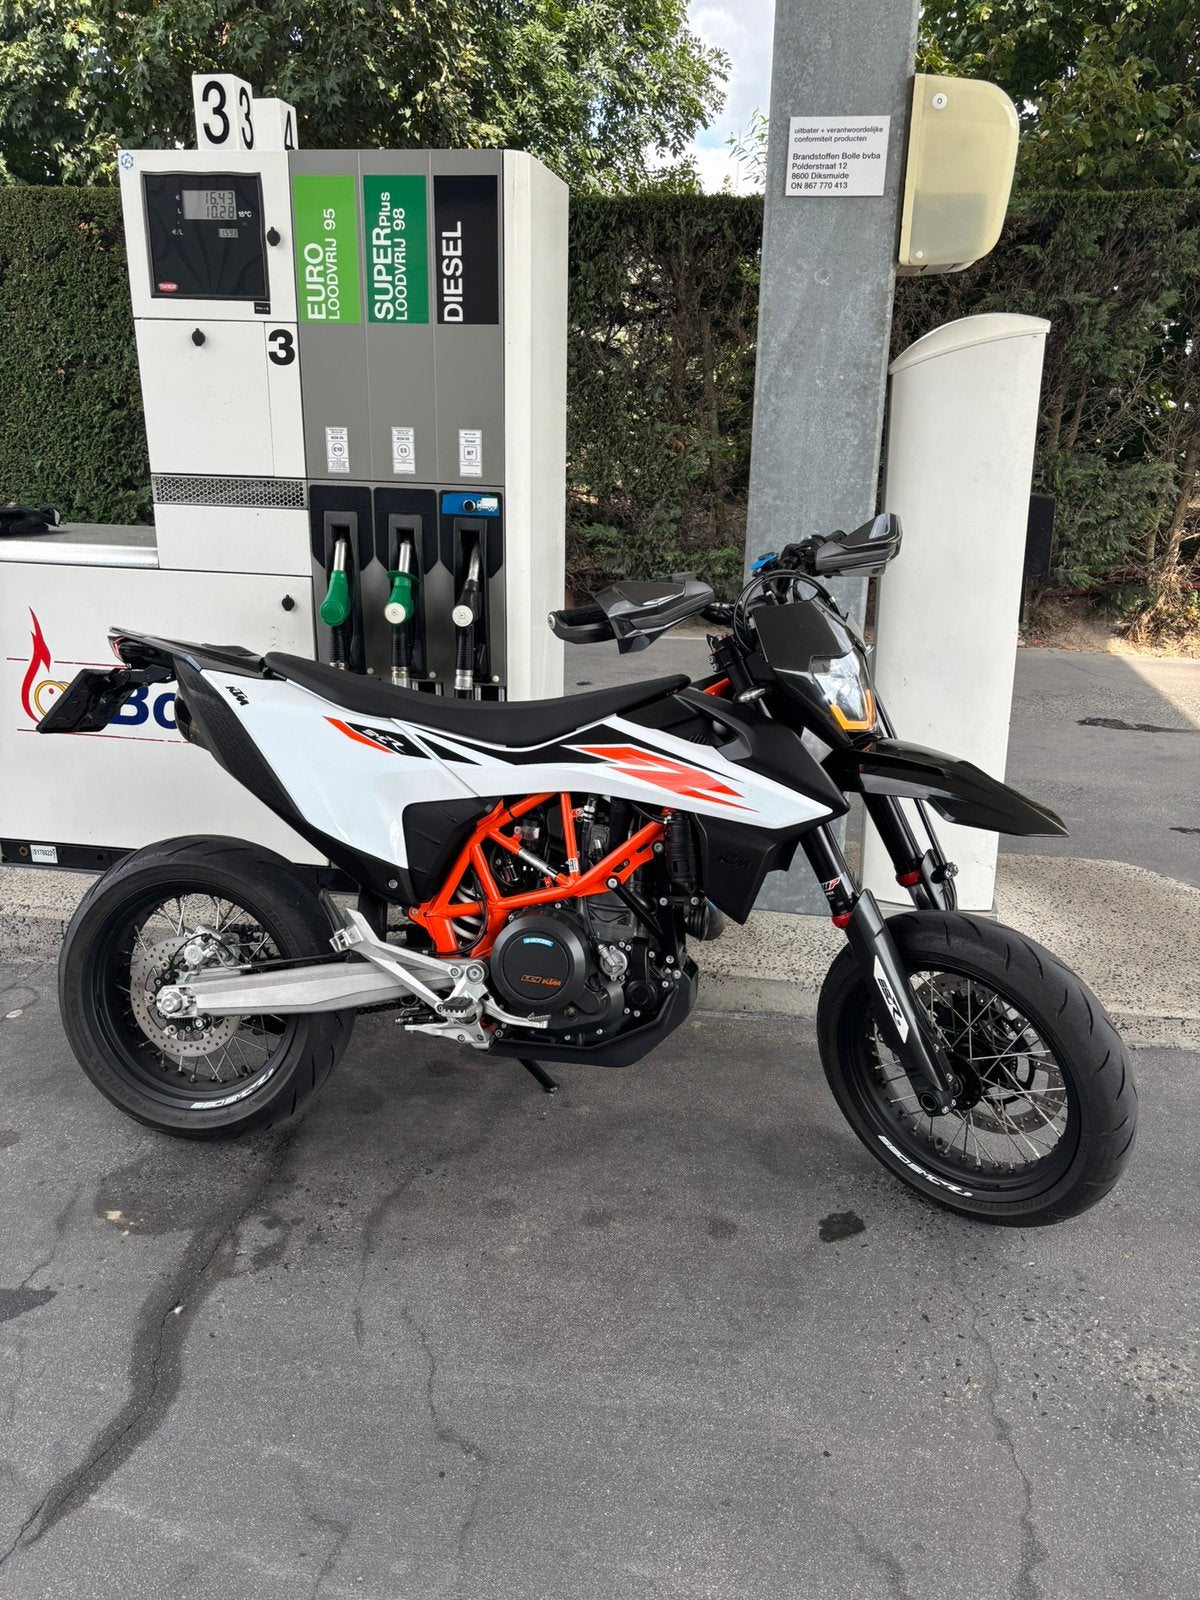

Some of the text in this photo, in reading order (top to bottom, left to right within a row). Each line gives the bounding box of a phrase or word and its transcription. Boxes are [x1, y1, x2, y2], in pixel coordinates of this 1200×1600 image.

[202, 80, 230, 145] 3
[239, 86, 254, 151] 3
[284, 110, 295, 150] 4
[826, 126, 884, 135] verantwoordelijke
[792, 152, 881, 160] Brandstoffen Bolle bvba
[794, 135, 868, 143] conformiteit producten
[791, 171, 850, 180] 8600 Diksmuide
[792, 162, 848, 170] Polderstraat 12
[790, 181, 848, 190] ON 867 770 413
[303, 242, 327, 320] EURO
[323, 207, 340, 320] LOODVRIJ 95
[392, 207, 408, 320] LOODVRIJ 98
[441, 220, 464, 322] DIESEL
[268, 328, 296, 366] 3
[224, 685, 250, 707] KTM
